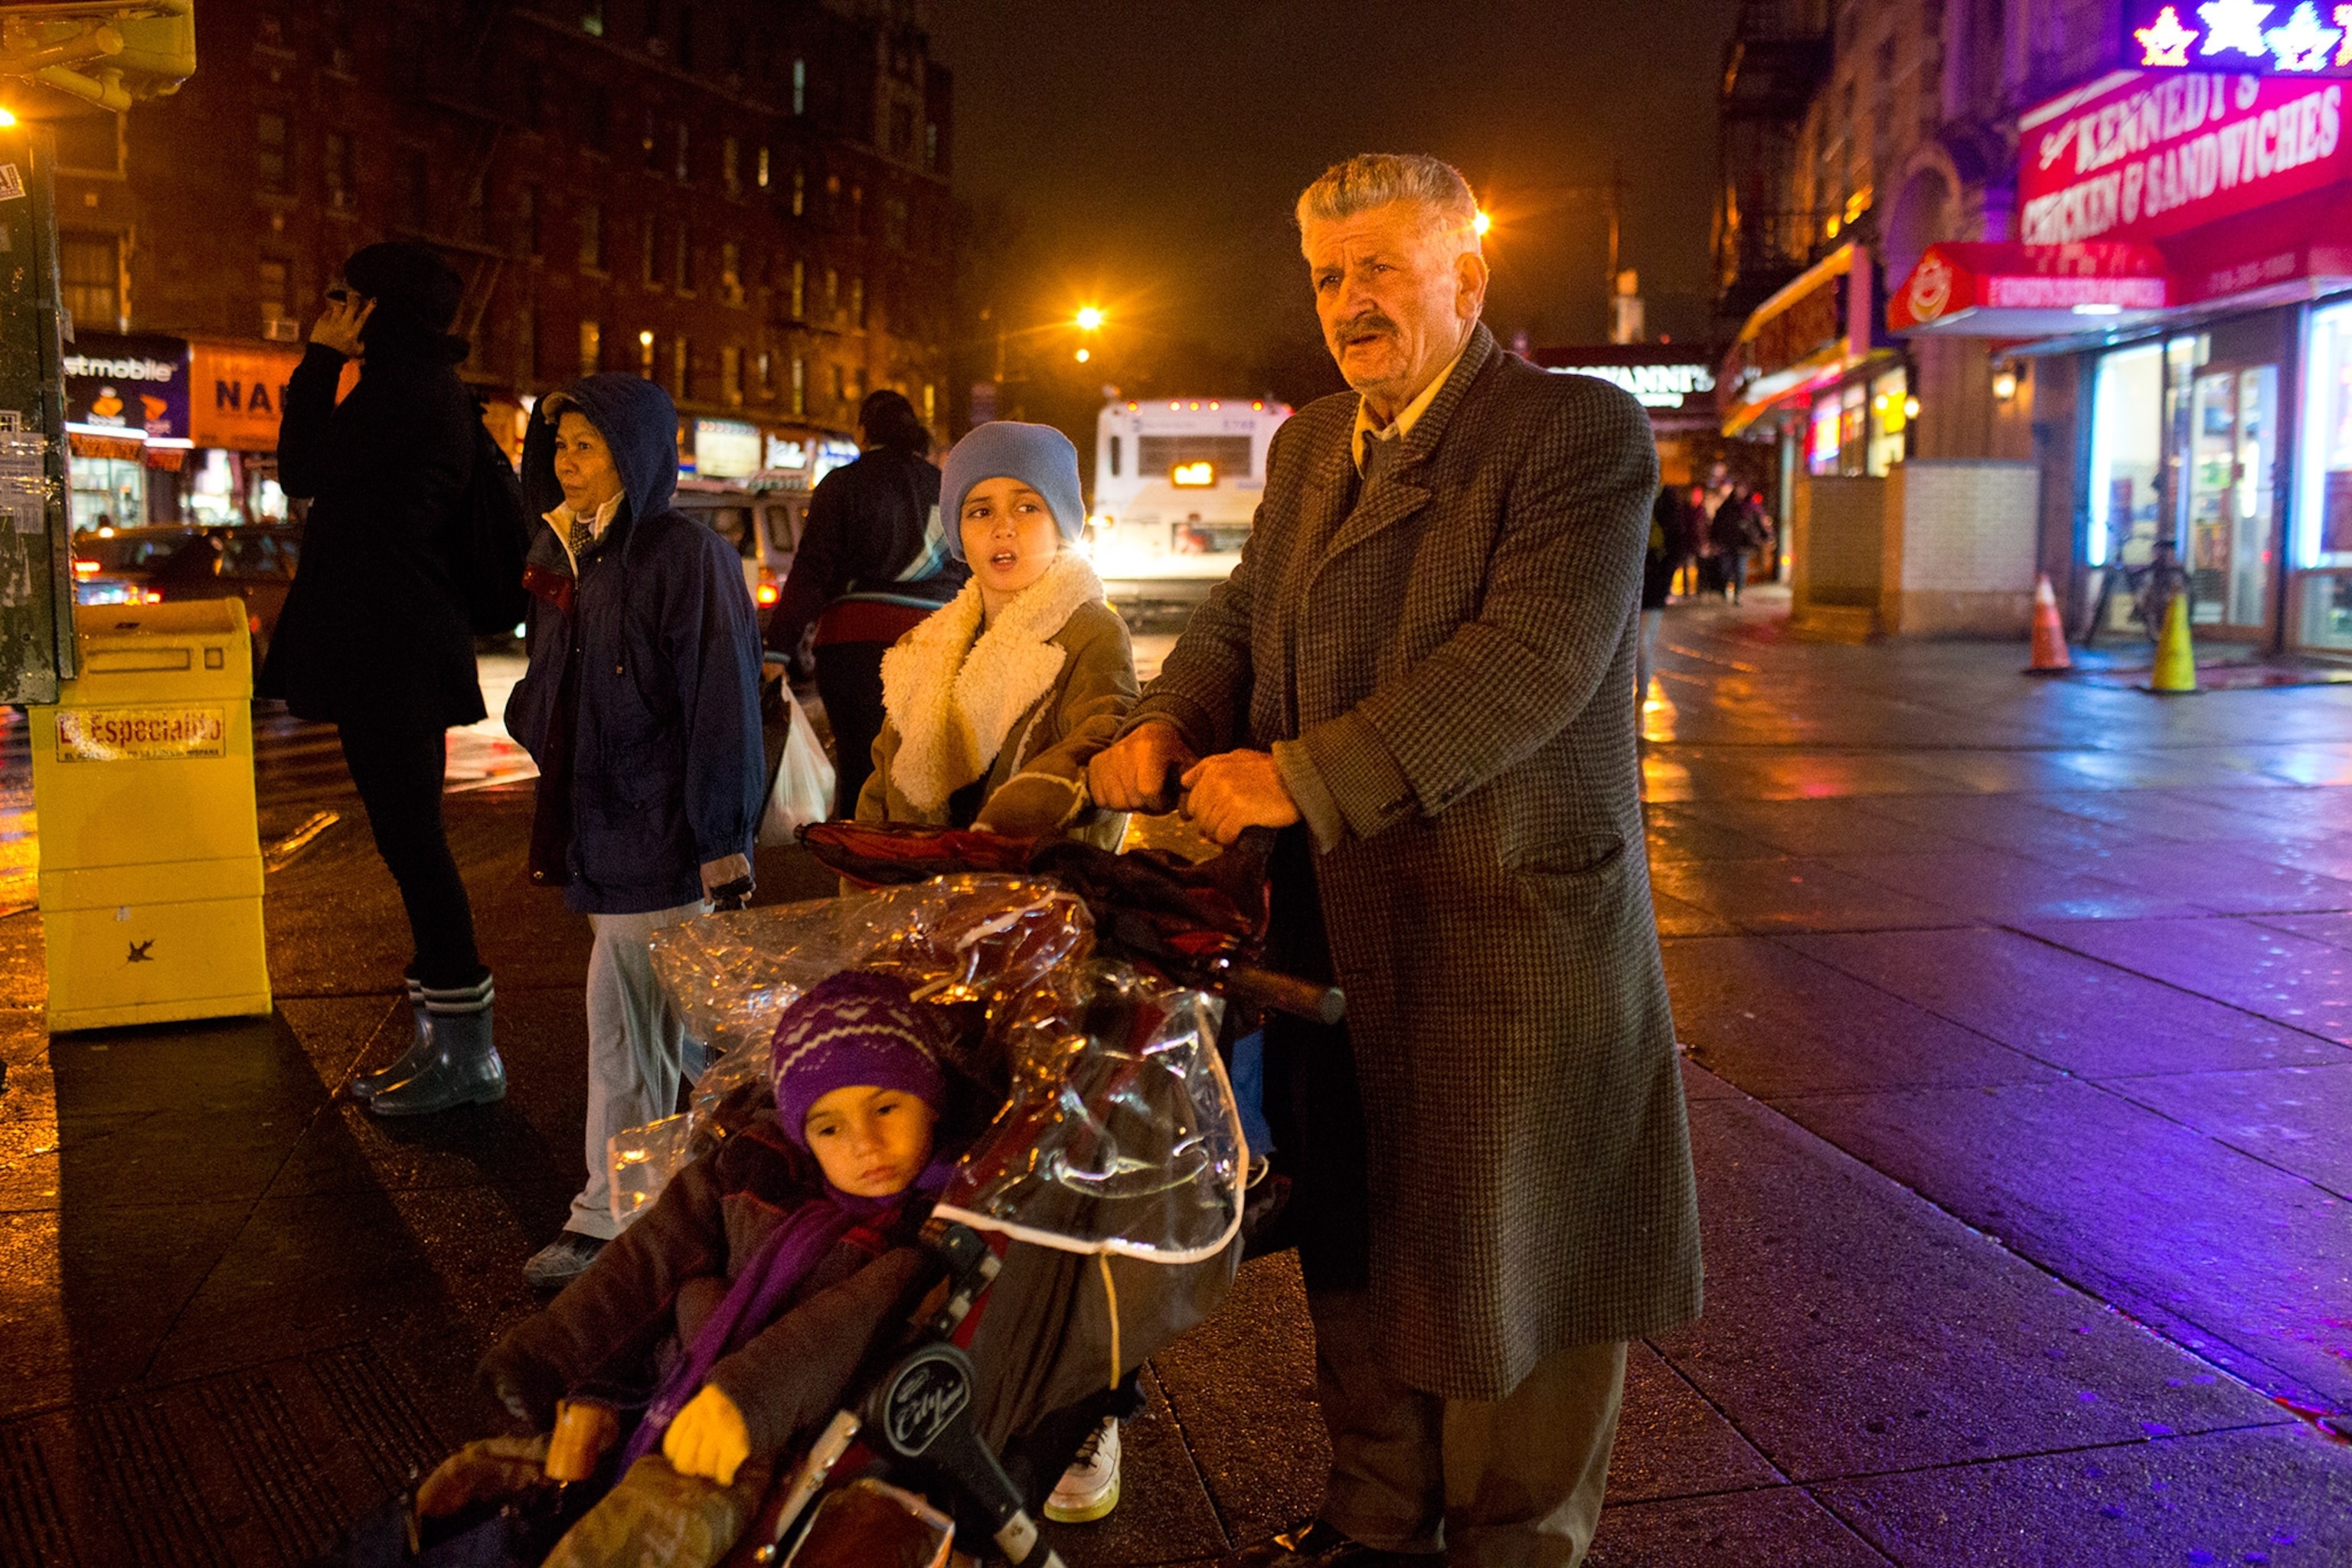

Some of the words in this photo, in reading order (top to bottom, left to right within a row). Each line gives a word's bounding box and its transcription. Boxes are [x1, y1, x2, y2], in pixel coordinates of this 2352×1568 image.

[2076, 73, 2261, 175] KENNEDYS
[2145, 85, 2341, 217] SANDWICHES
[1547, 364, 1717, 393] VANNI'S
[90, 713, 221, 748] Especialito
